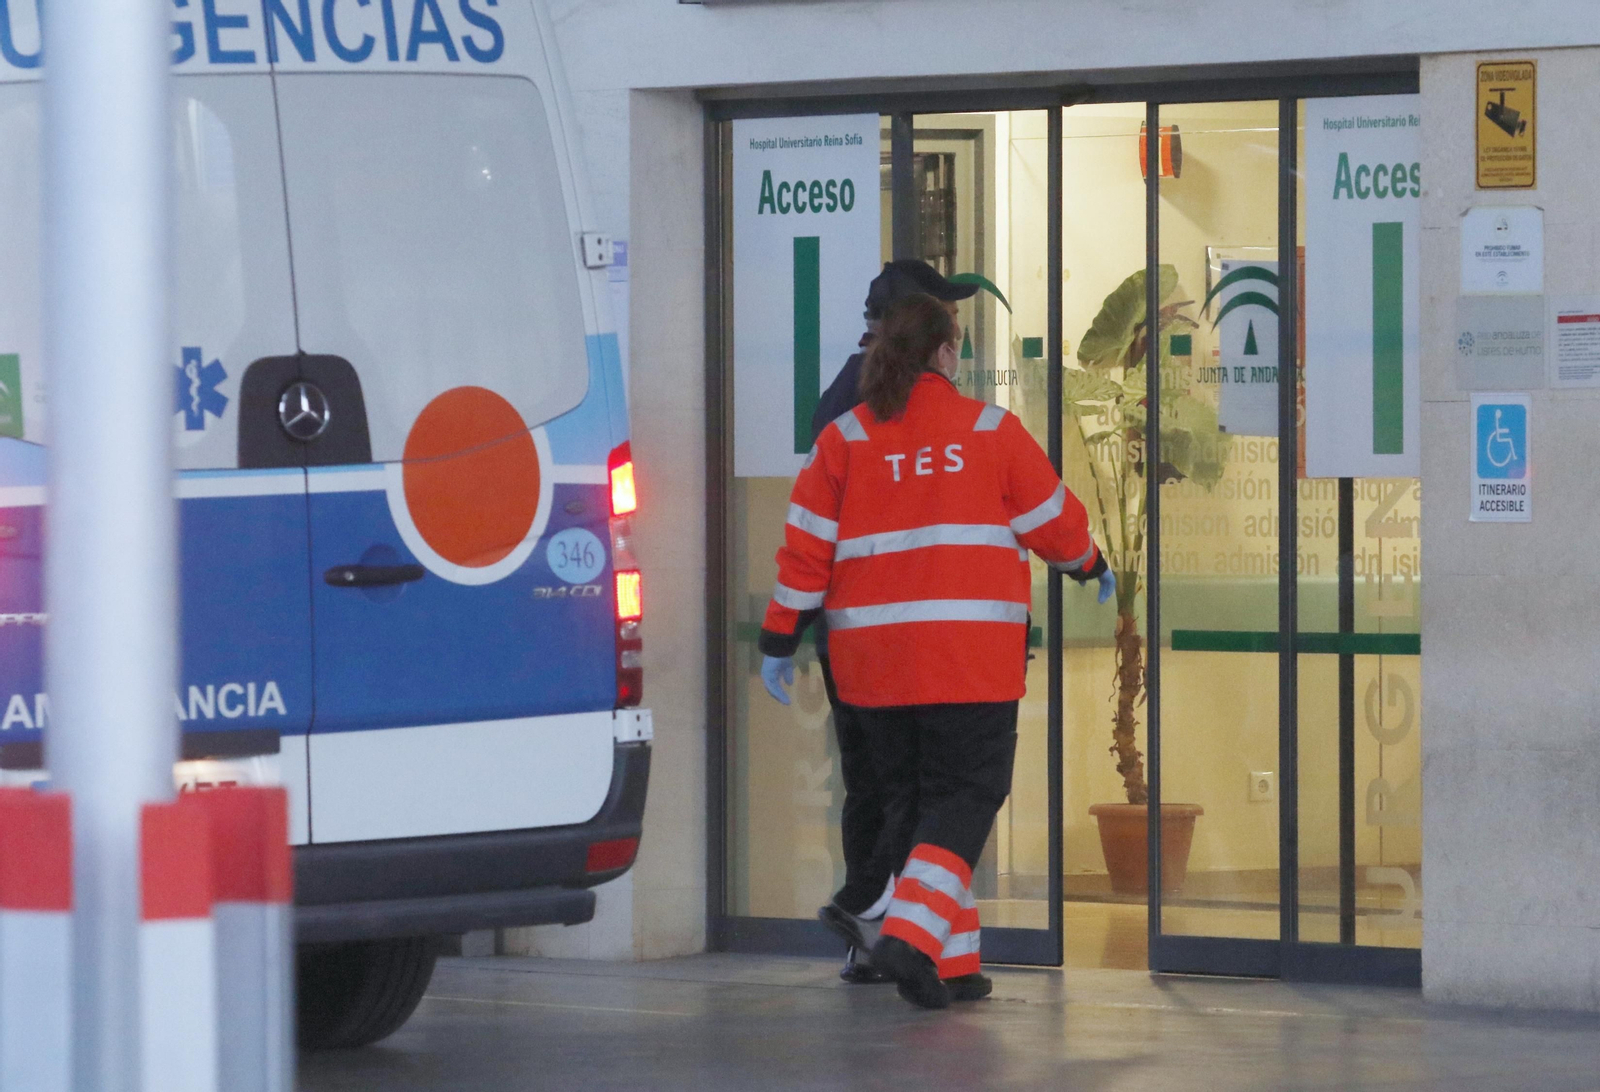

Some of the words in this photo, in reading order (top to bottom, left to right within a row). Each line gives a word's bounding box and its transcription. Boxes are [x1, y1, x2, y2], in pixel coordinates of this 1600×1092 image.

[1323, 116, 1355, 132] Hospital
[1356, 114, 1407, 129] Universitario
[1408, 114, 1421, 127] Rei
[749, 137, 778, 151] Hospital
[779, 134, 823, 149] Universitario
[824, 134, 844, 146] Reina
[844, 132, 863, 146] Sofía
[1332, 151, 1420, 200] Acces
[757, 169, 855, 215] Acceso
[1197, 366, 1229, 384] JUNTA
[1234, 366, 1246, 384] DE
[884, 444, 964, 482] TES
[1478, 484, 1526, 496] ITINERARIO
[1479, 500, 1525, 512] ACCESIBLE
[557, 541, 595, 569] 346
[1364, 477, 1418, 930] URGEN
